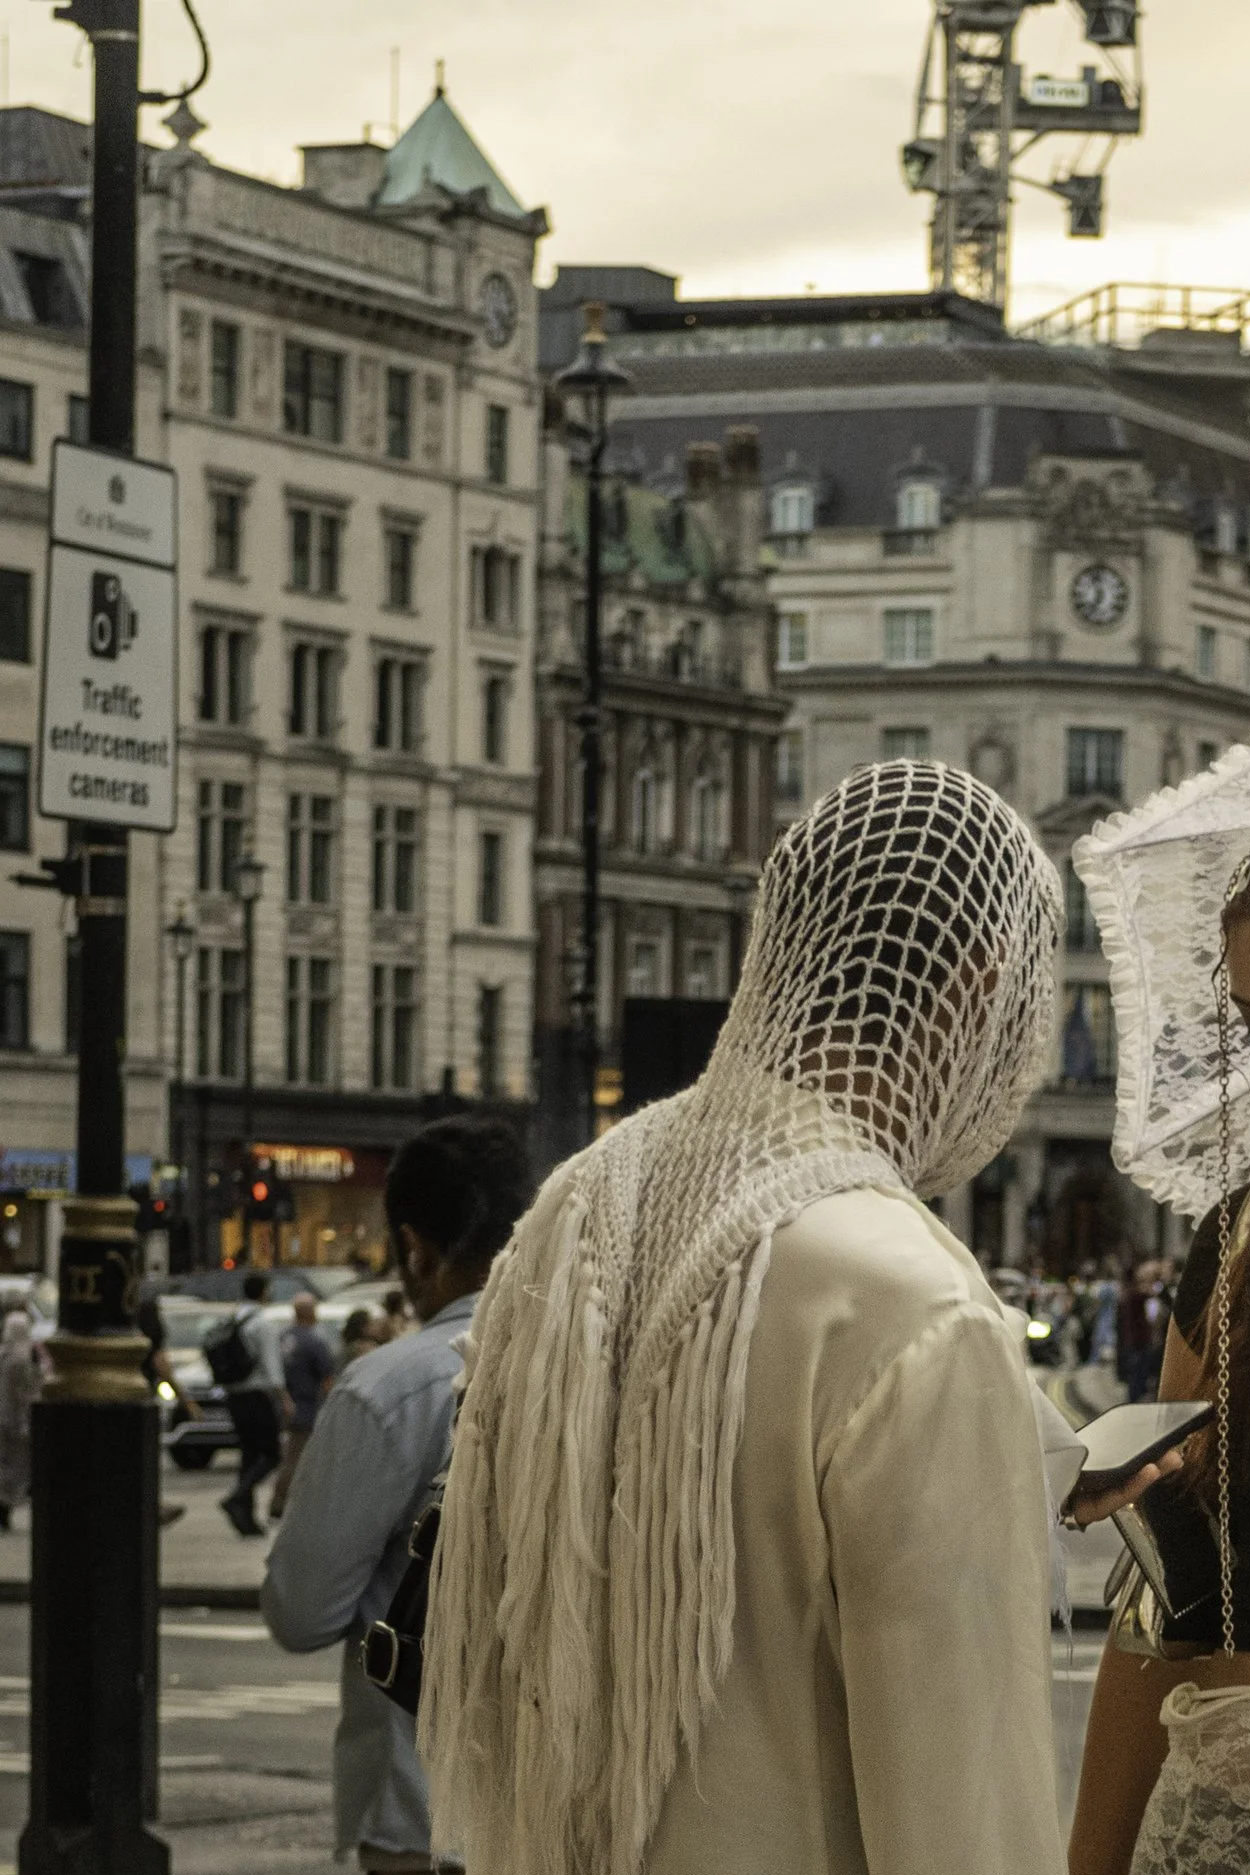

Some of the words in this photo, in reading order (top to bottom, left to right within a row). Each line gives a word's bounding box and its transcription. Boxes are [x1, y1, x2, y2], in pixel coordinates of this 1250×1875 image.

[81, 678, 142, 720] Traffic
[49, 721, 168, 768] enforcement
[68, 772, 149, 807] cameras
